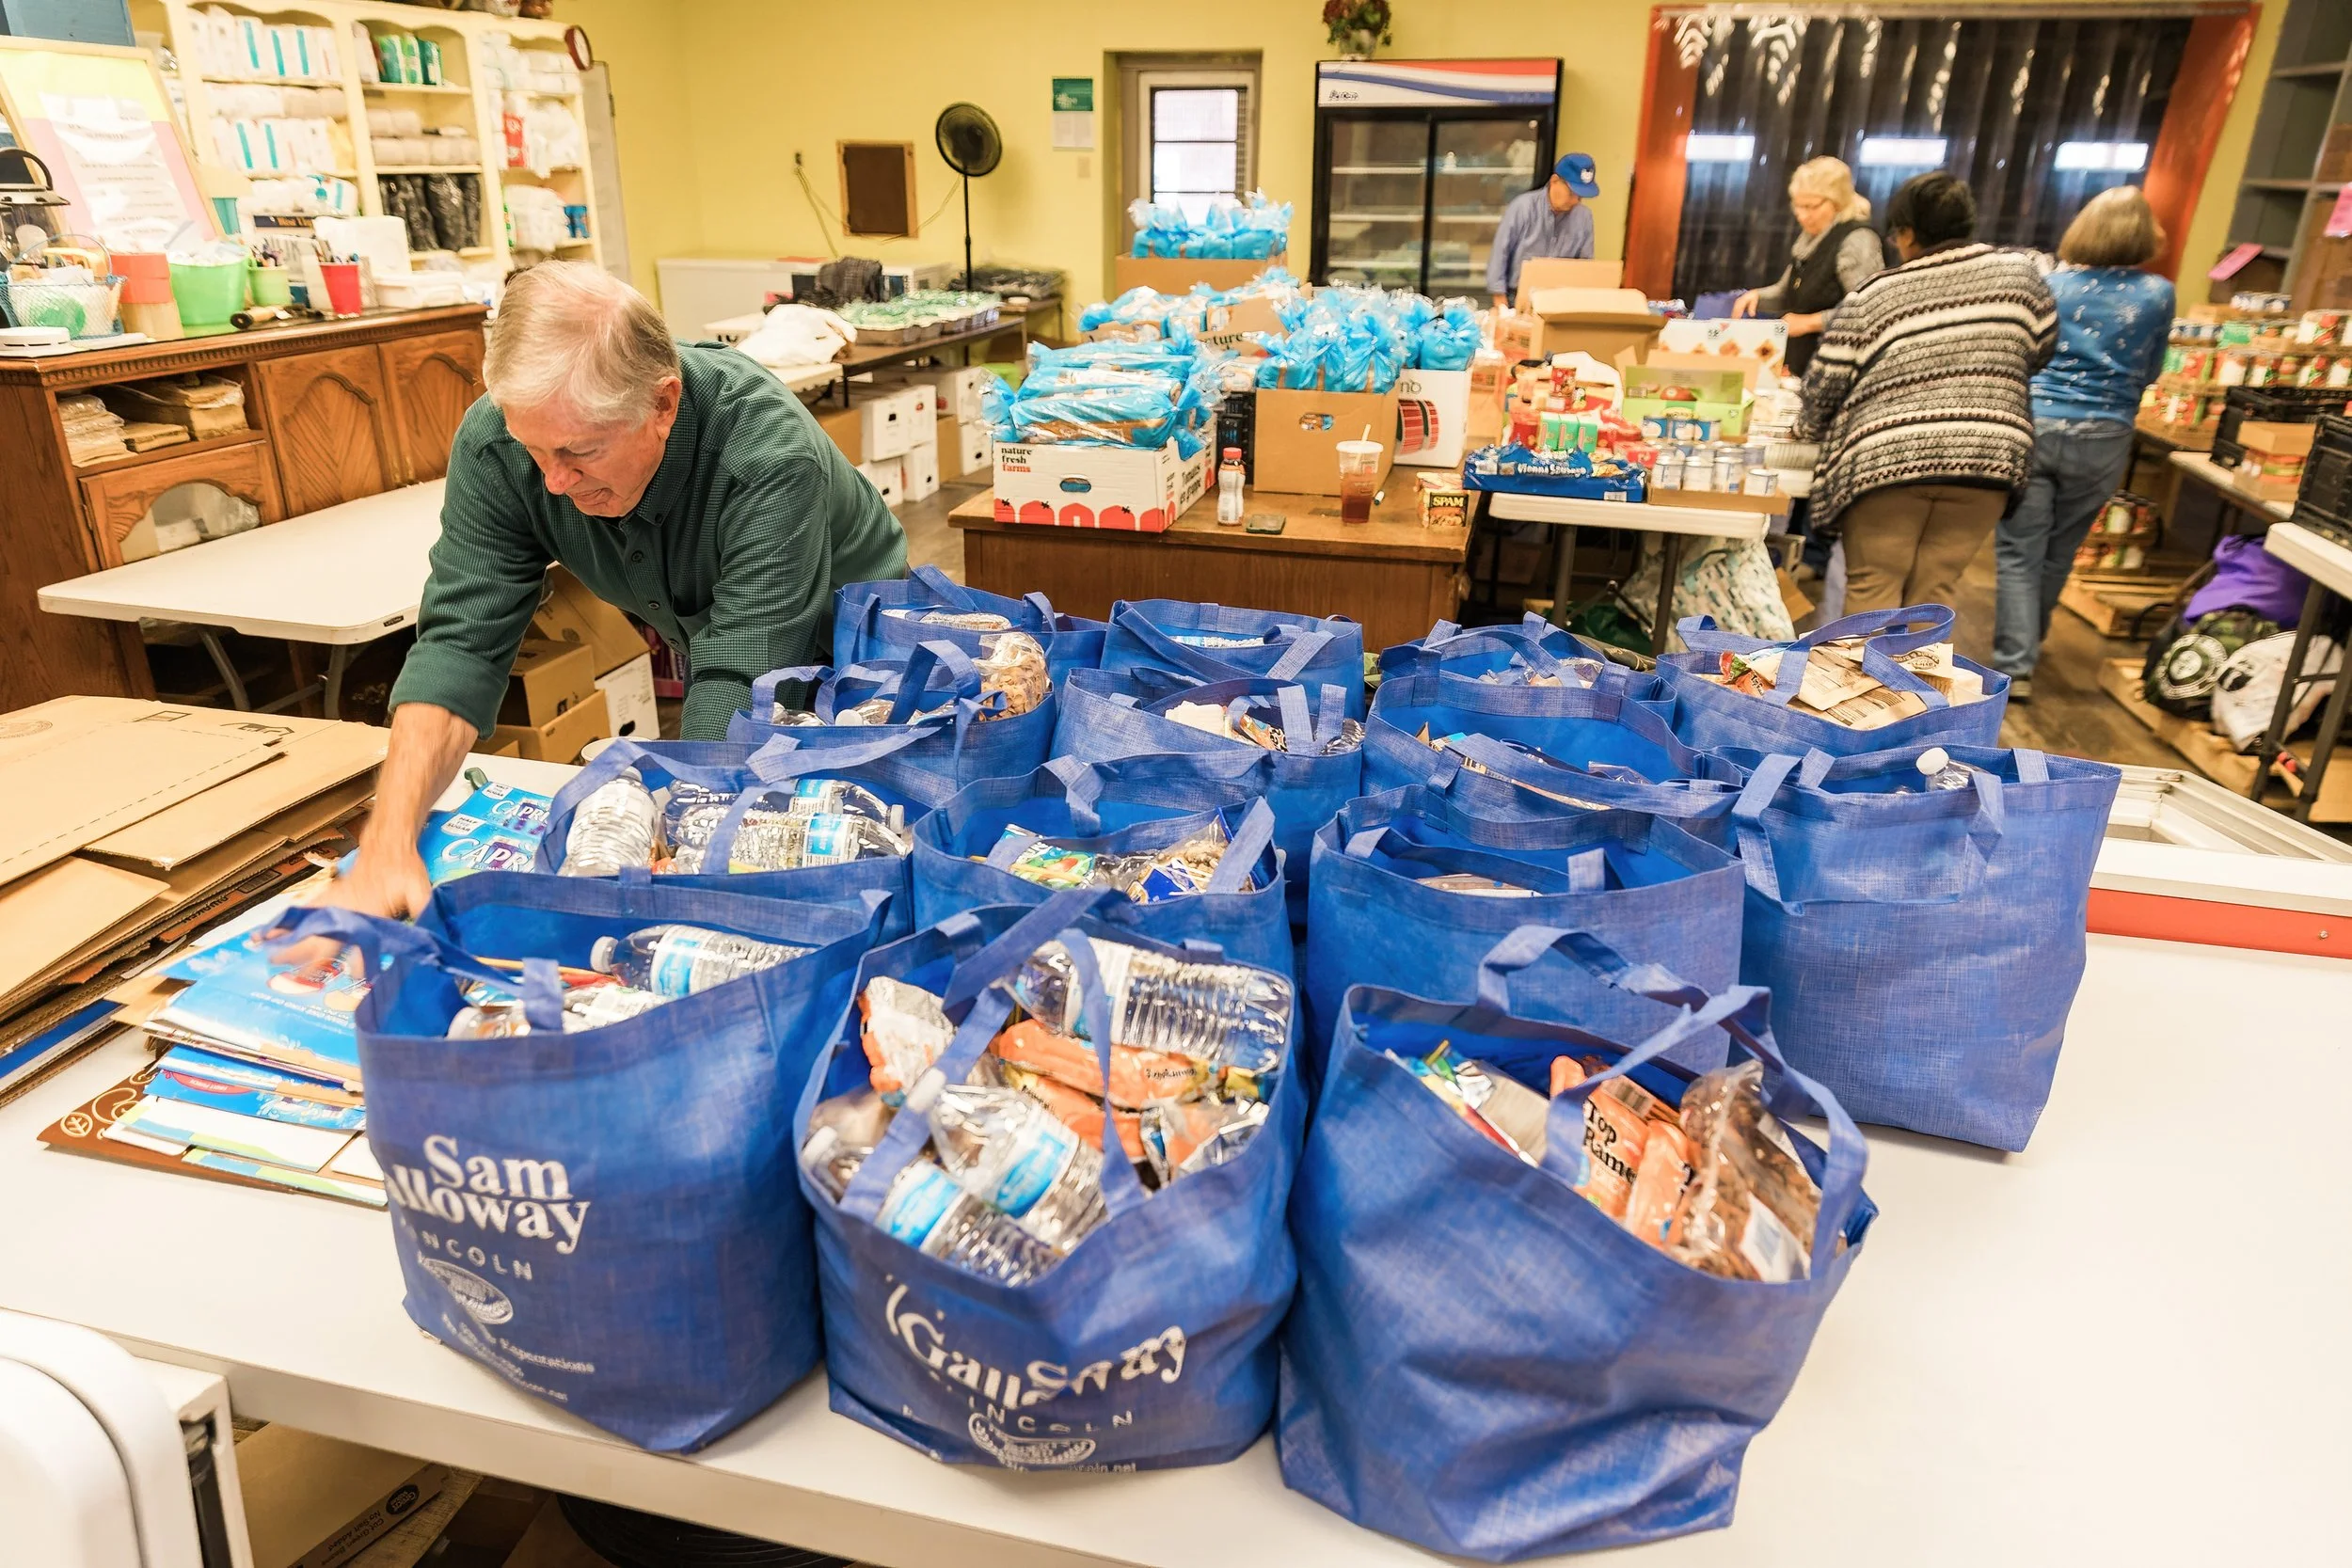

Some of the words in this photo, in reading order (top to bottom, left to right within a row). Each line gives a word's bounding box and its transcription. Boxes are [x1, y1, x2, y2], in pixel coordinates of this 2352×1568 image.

[1002, 455, 1026, 464] fresh
[1518, 463, 1549, 474] Vienna
[1433, 497, 1464, 507] SPAM
[441, 838, 533, 872] CAPR
[1584, 1097, 1617, 1147] Top
[423, 1134, 573, 1200] Sam
[1582, 1126, 1638, 1185] Rame
[385, 1164, 591, 1255] lloway
